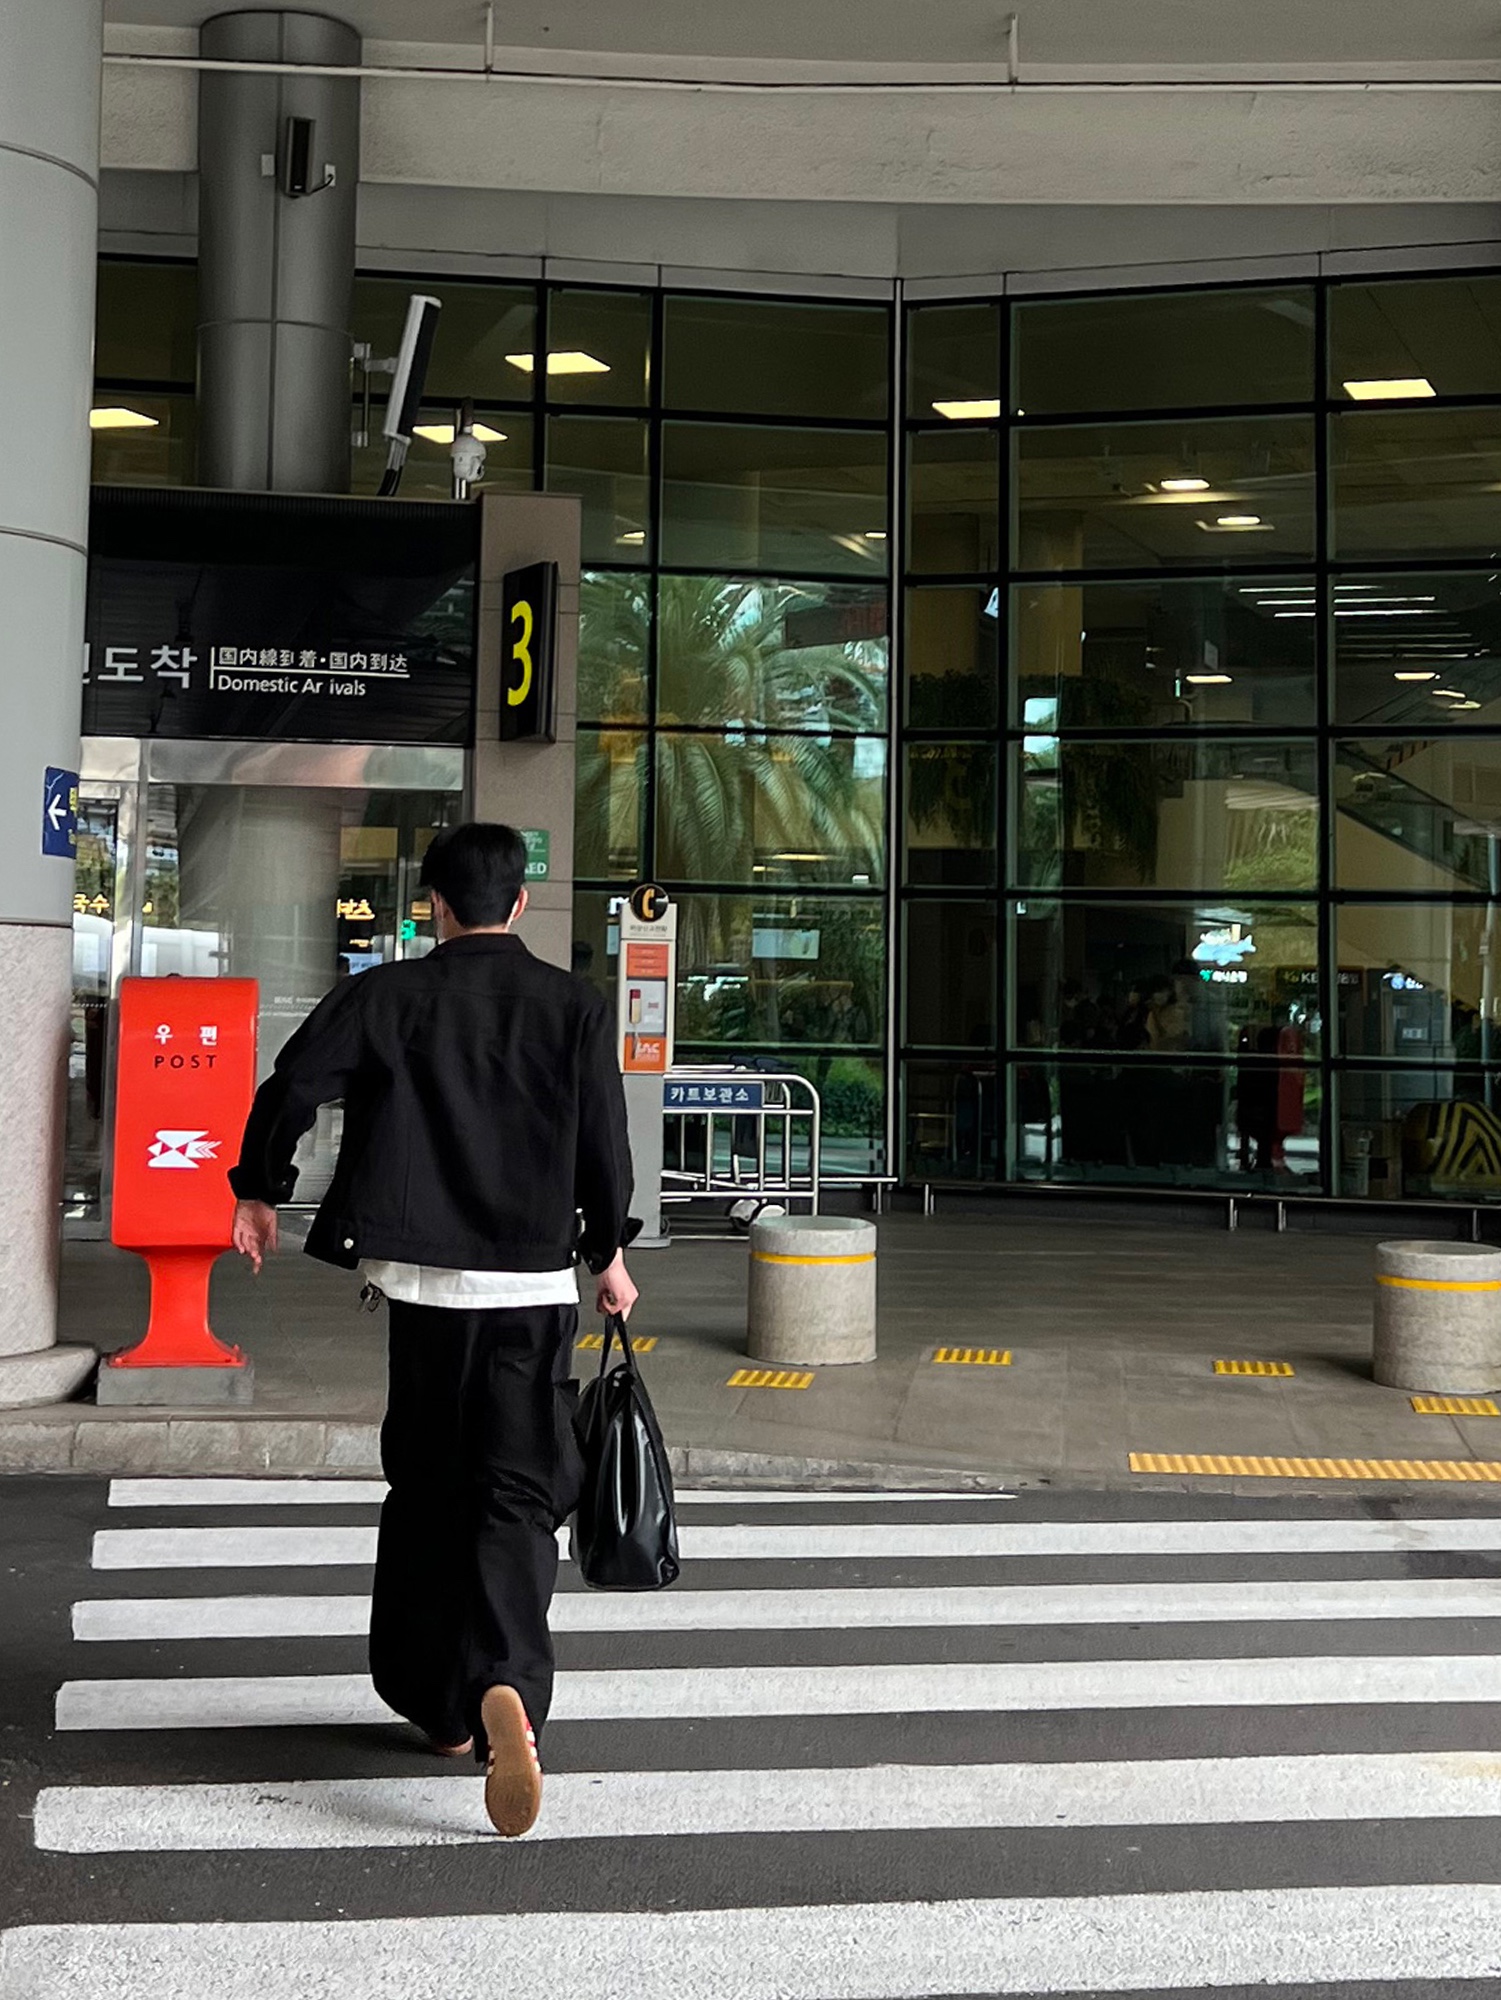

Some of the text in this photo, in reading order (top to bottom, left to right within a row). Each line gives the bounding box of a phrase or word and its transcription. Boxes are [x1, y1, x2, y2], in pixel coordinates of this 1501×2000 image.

[507, 600, 533, 707] 3
[218, 674, 298, 694] Domestic
[154, 1054, 218, 1069] POST
[669, 1087, 749, 1104] 카트보관소
